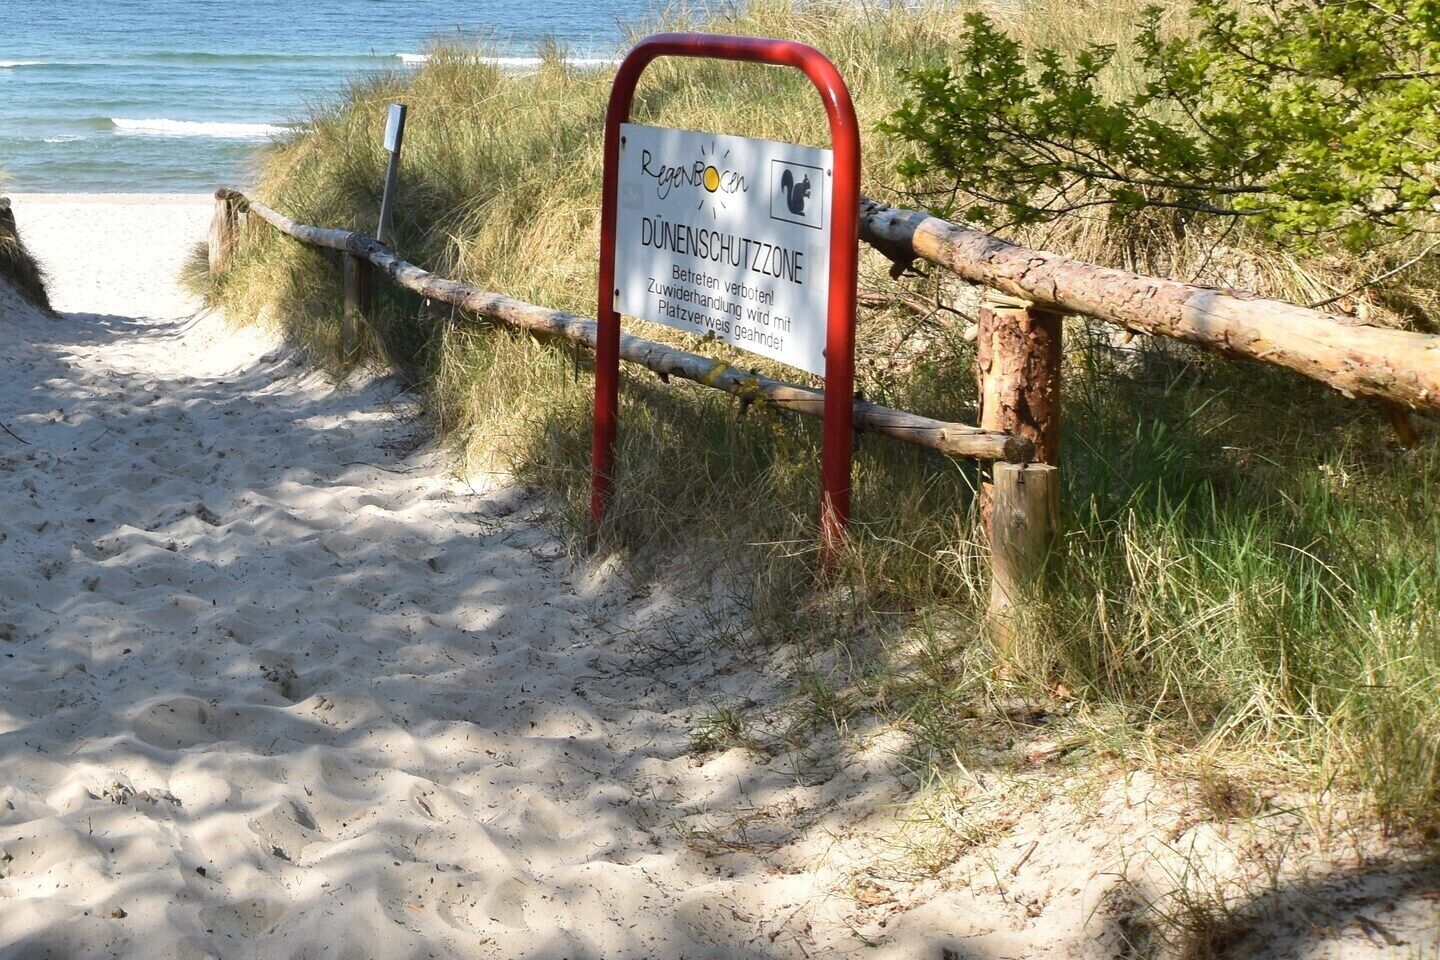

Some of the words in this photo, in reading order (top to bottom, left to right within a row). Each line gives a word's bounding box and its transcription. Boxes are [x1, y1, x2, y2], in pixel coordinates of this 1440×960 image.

[641, 214, 804, 285] DÜNENSCHUTZZONE
[647, 277, 742, 320] Zuwiderhandlung
[746, 306, 770, 326] wird
[773, 315, 792, 333] mit
[672, 264, 720, 291] Betreten
[724, 280, 774, 306] verboten!
[658, 299, 730, 334] Platzverweis
[734, 324, 784, 352] geahndet
